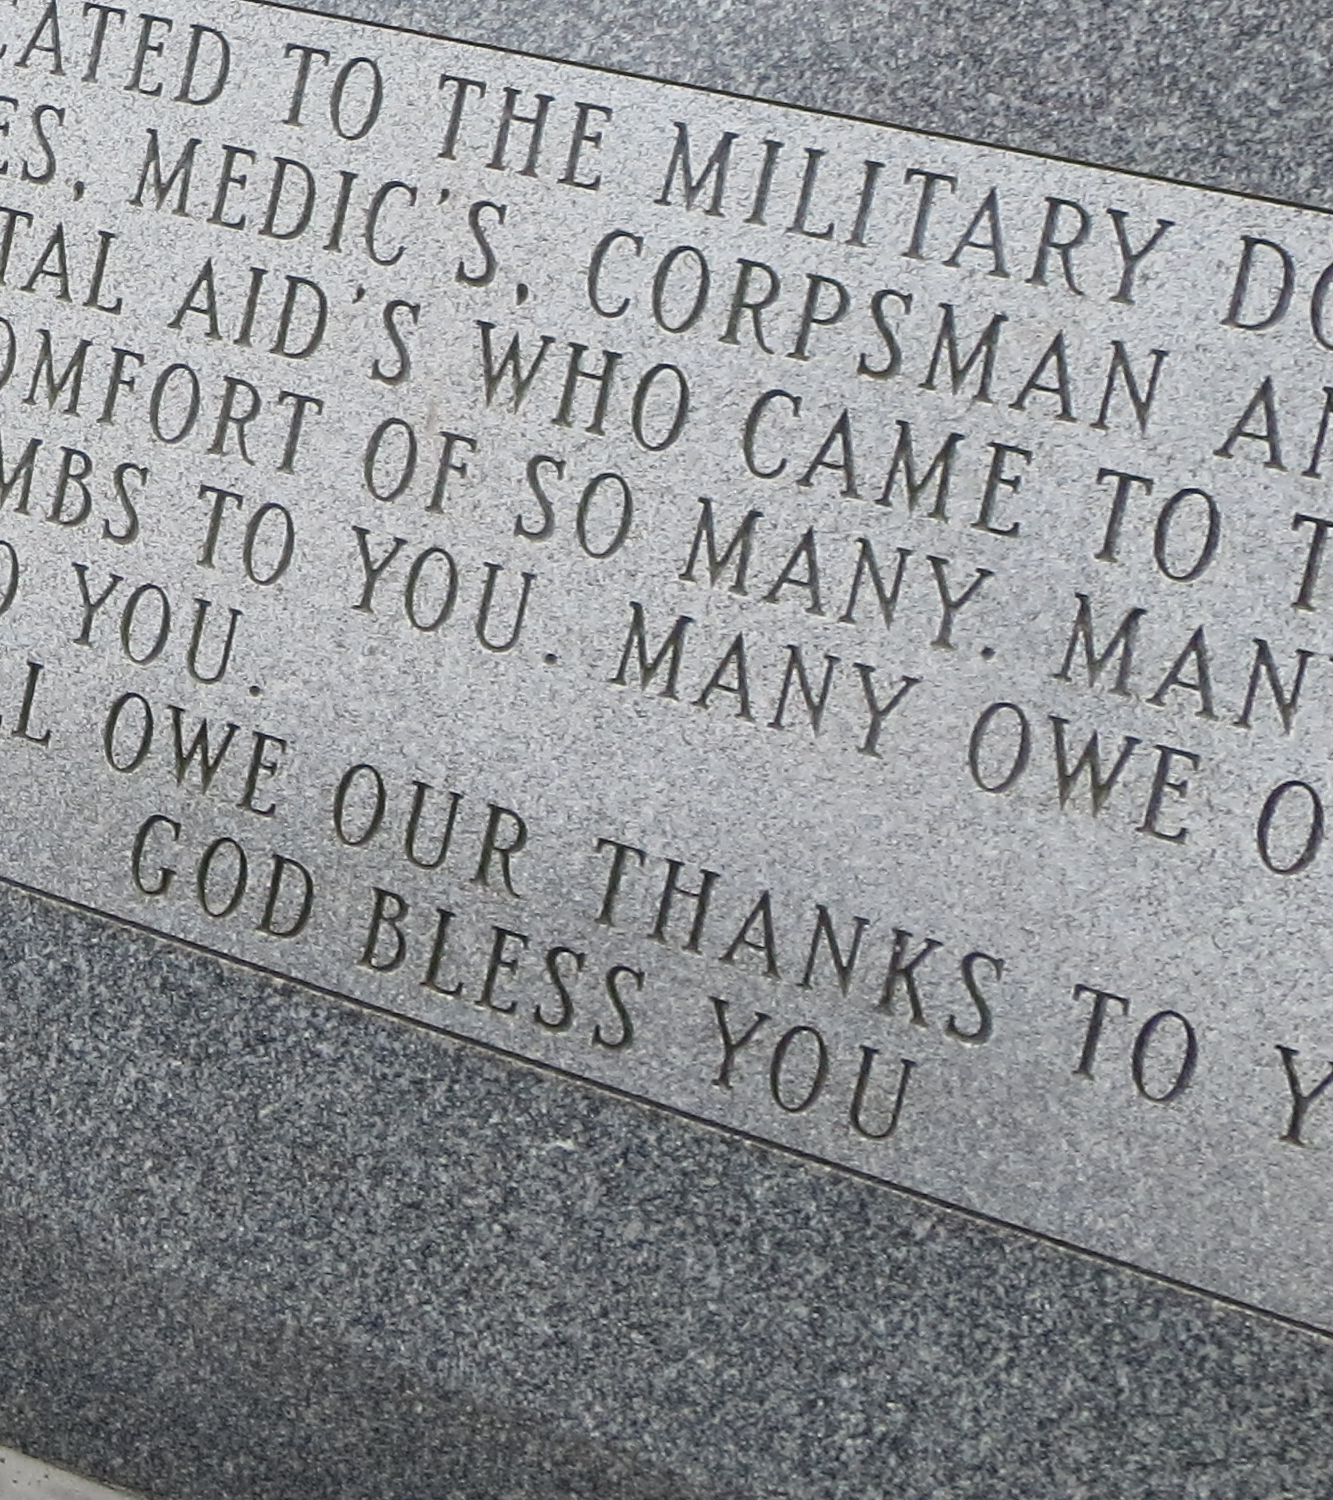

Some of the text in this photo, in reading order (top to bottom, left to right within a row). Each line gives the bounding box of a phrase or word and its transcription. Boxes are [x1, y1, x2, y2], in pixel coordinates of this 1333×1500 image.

[130, 129, 530, 303] MEDIC'S,
[588, 230, 1167, 433] CORPSMAN
[281, 43, 385, 141] TO
[438, 74, 613, 191] THE
[654, 121, 1176, 305] MILITARY
[167, 258, 420, 386] AID'S
[476, 320, 689, 451] WHO
[744, 389, 1032, 537] CAME
[1095, 469, 1221, 581] TO
[363, 418, 477, 514] OF
[514, 456, 633, 559] SO
[678, 500, 997, 660] MANY.
[1053, 592, 1333, 734] MAN
[70, 562, 263, 697] YOU.
[197, 484, 295, 586] TO
[350, 526, 558, 666] YOU.
[610, 600, 921, 758] MANY
[969, 702, 1202, 844] OWE
[104, 693, 289, 816] OWE
[334, 763, 528, 897] OUR
[594, 837, 1005, 1045] THANKS
[1071, 983, 1198, 1102] TO
[134, 814, 917, 1141] GOD BLESS YOU
